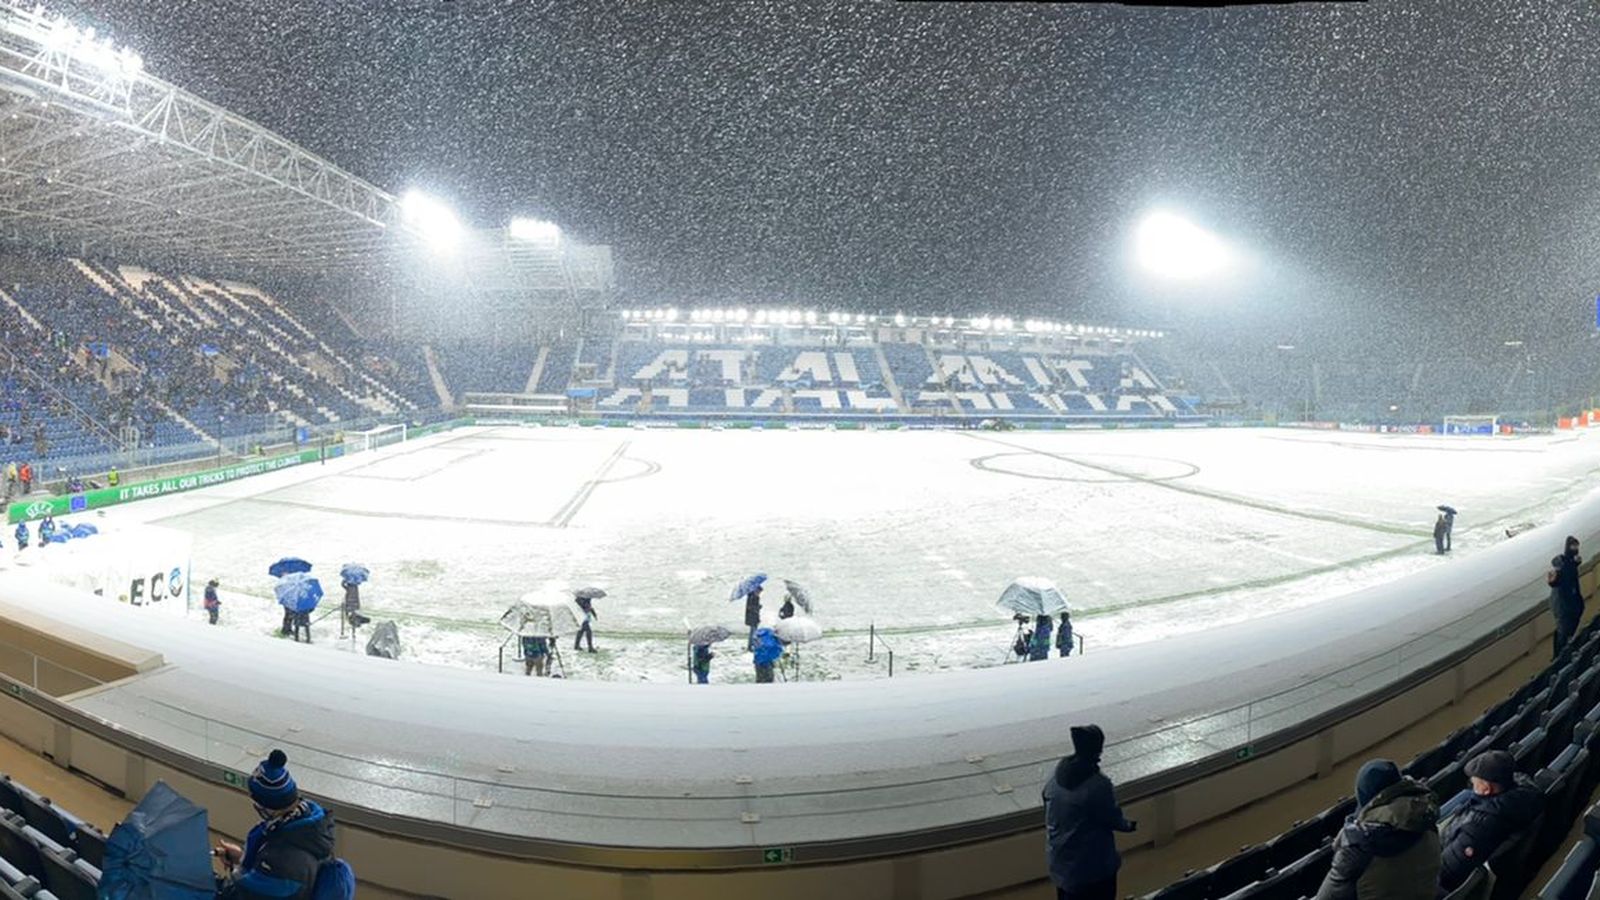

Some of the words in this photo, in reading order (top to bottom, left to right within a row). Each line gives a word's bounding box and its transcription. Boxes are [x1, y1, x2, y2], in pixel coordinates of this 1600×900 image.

[119, 488, 129, 500] IT
[132, 482, 160, 497] TAKES
[161, 480, 178, 492] ALL
[179, 477, 197, 489] OUR
[198, 471, 225, 486] TRICKS
[226, 469, 235, 480] TO
[235, 462, 264, 478] PROTECT
[265, 460, 277, 471] THE
